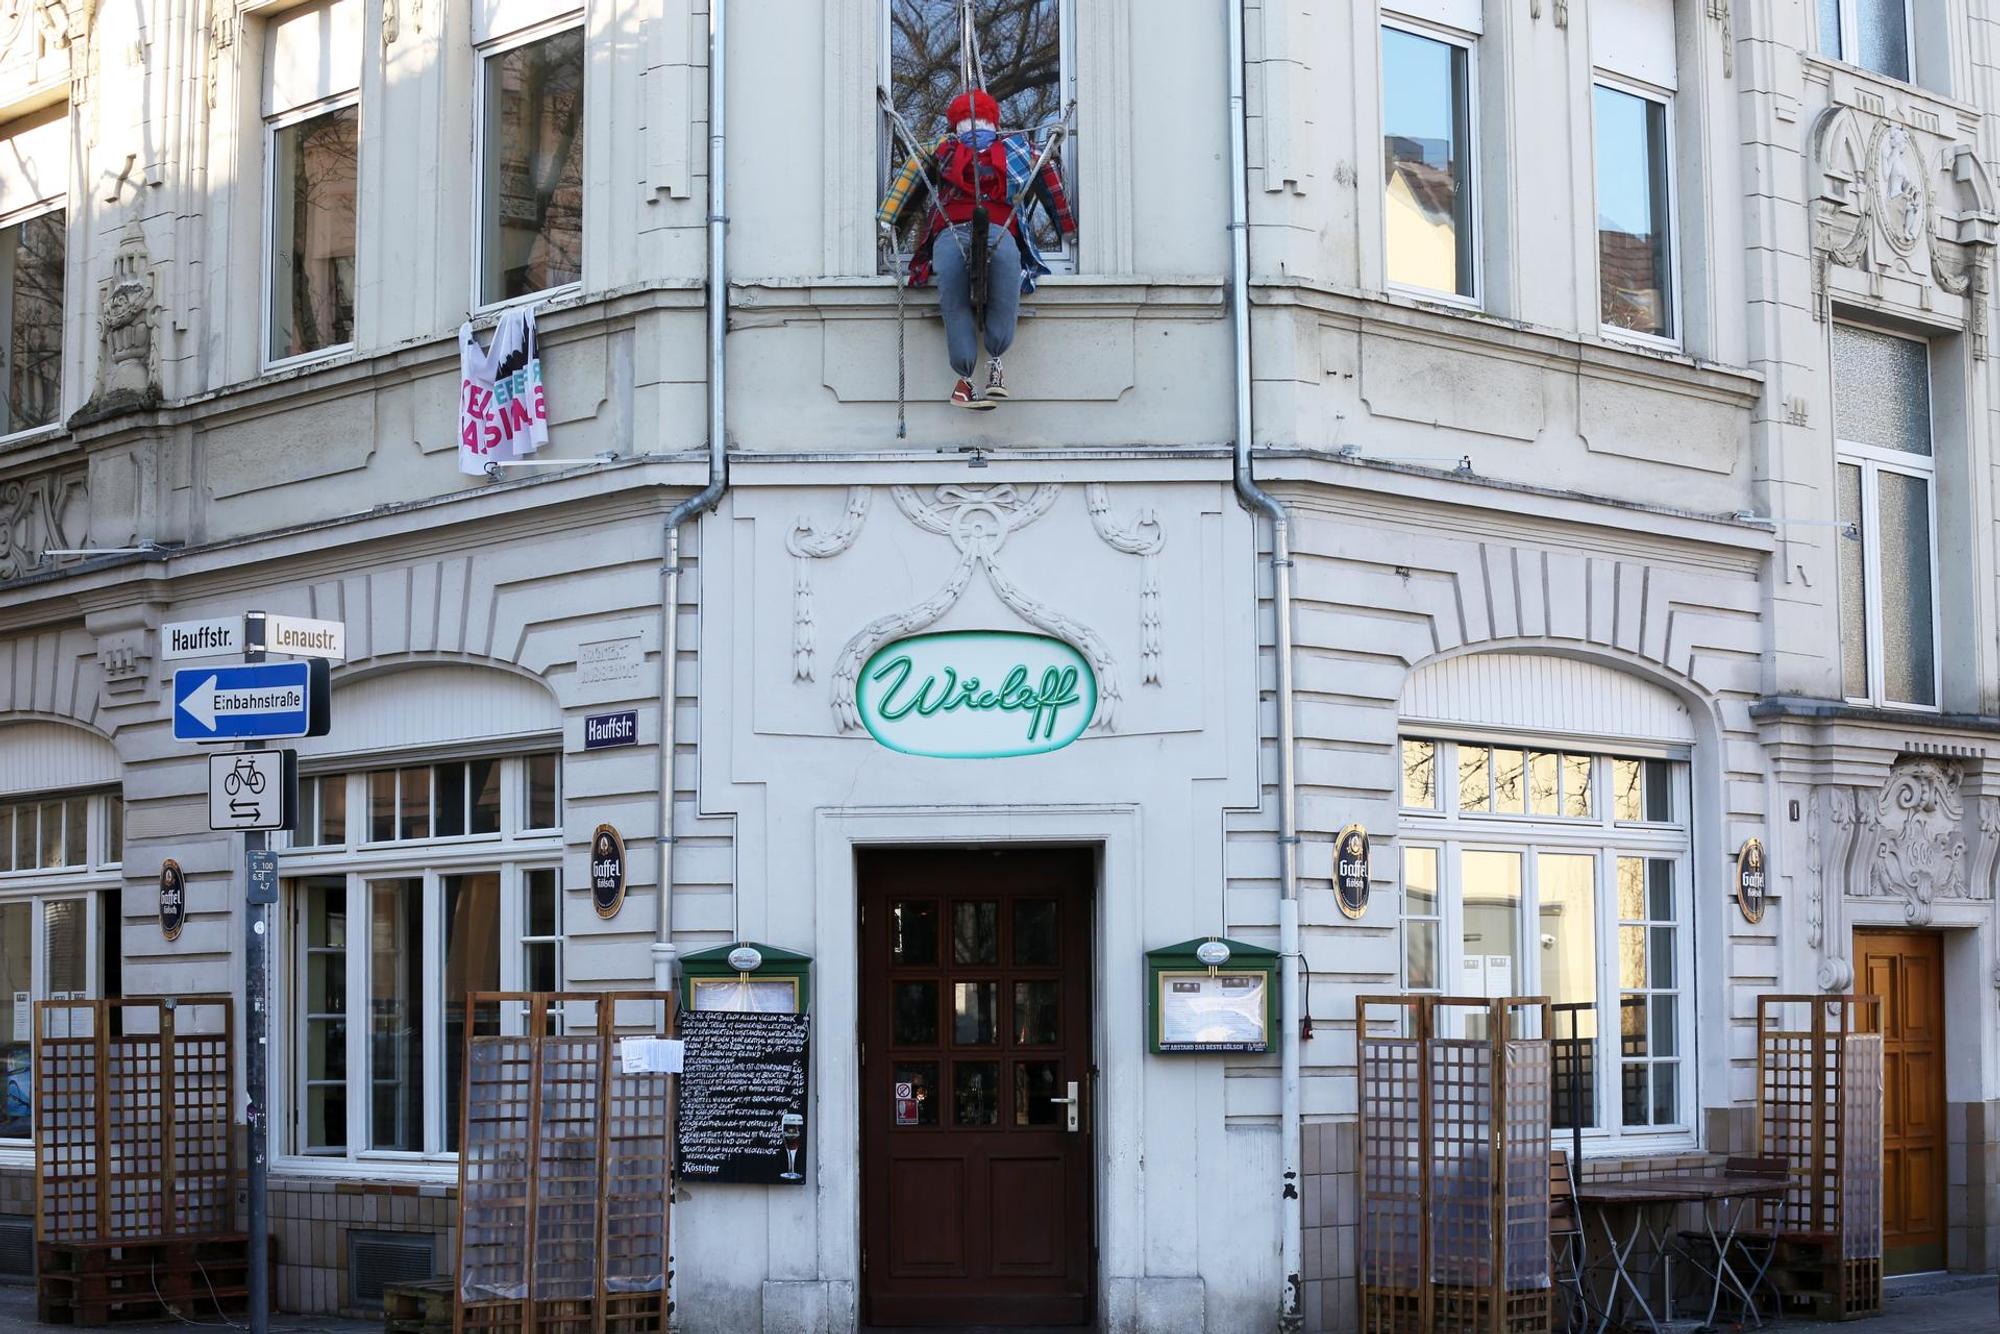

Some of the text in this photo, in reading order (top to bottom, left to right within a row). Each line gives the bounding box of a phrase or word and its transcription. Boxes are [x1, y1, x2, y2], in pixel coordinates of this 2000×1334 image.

[172, 626, 232, 651] Hauffstr.
[276, 623, 336, 650] Lenaustr.
[213, 691, 300, 711] Einbahnstraße
[872, 655, 1080, 740] Wicleff
[588, 715, 632, 741] Hauffstr.
[252, 862, 273, 870] S 100
[593, 859, 621, 878] Gaffel
[1340, 859, 1368, 878] Gaffel
[160, 889, 182, 905] Gaffel
[682, 1161, 720, 1174] Köstritzer
